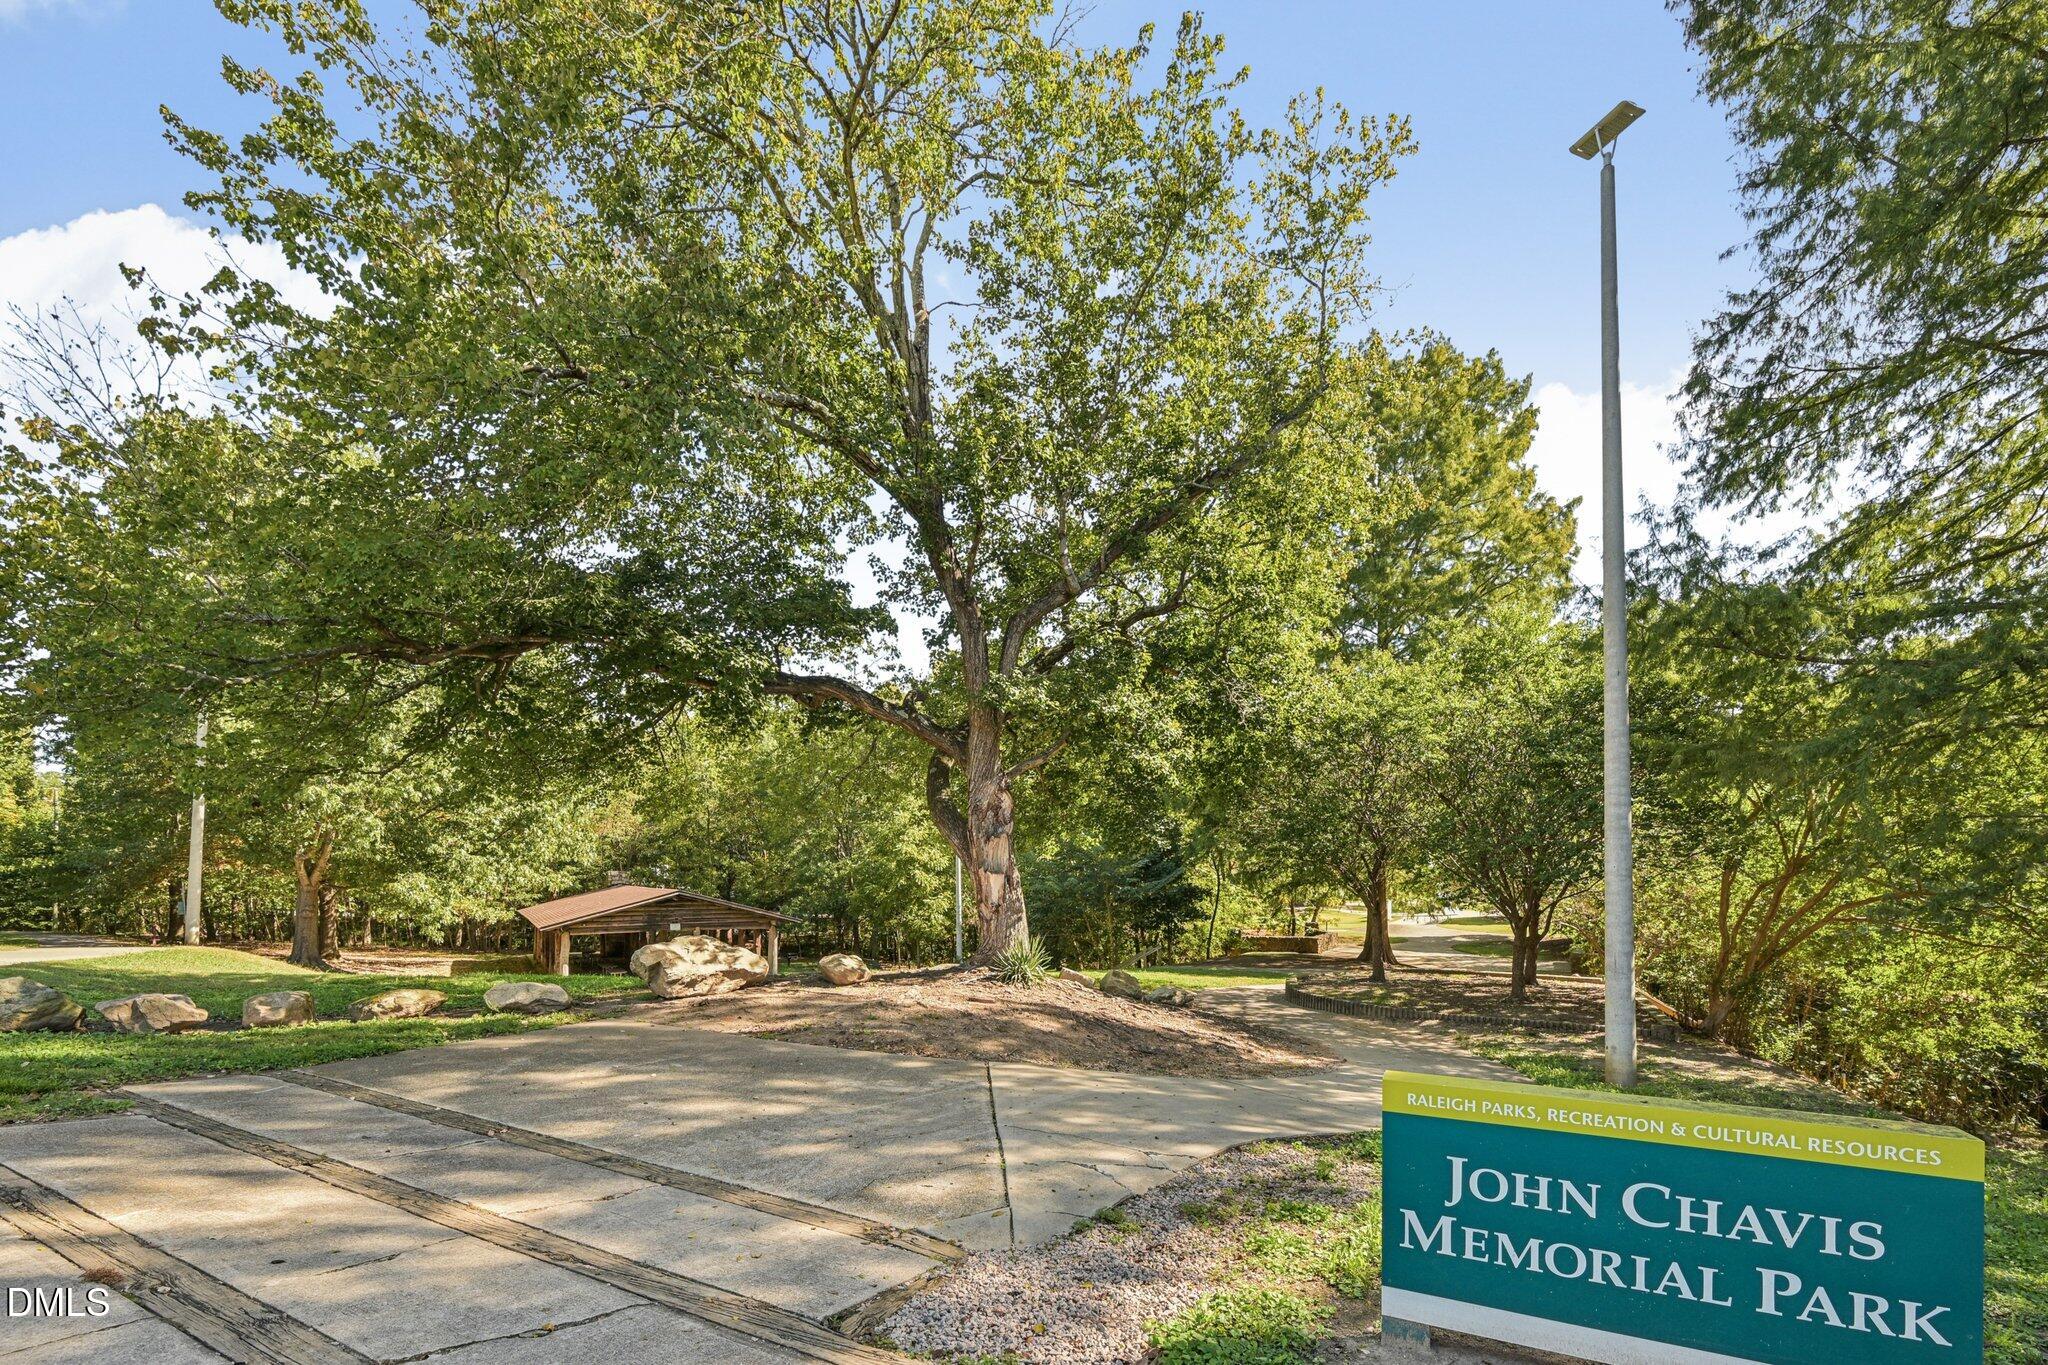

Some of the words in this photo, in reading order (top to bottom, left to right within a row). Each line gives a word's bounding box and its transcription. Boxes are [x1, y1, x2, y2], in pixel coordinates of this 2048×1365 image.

[1407, 1092, 1476, 1112] RALEIGH
[1482, 1101, 1541, 1122] PARKS,
[1547, 1108, 1664, 1134] RECREATION
[1671, 1122, 1686, 1137] &
[1693, 1125, 1800, 1149] CULTURAL
[1808, 1137, 1942, 1166] RESOURCES
[1444, 1155, 1600, 1219] JOHN
[1622, 1182, 1885, 1261] CHAVIS
[1399, 1208, 1733, 1307] MEMORIAL
[1755, 1267, 1953, 1347] PARK
